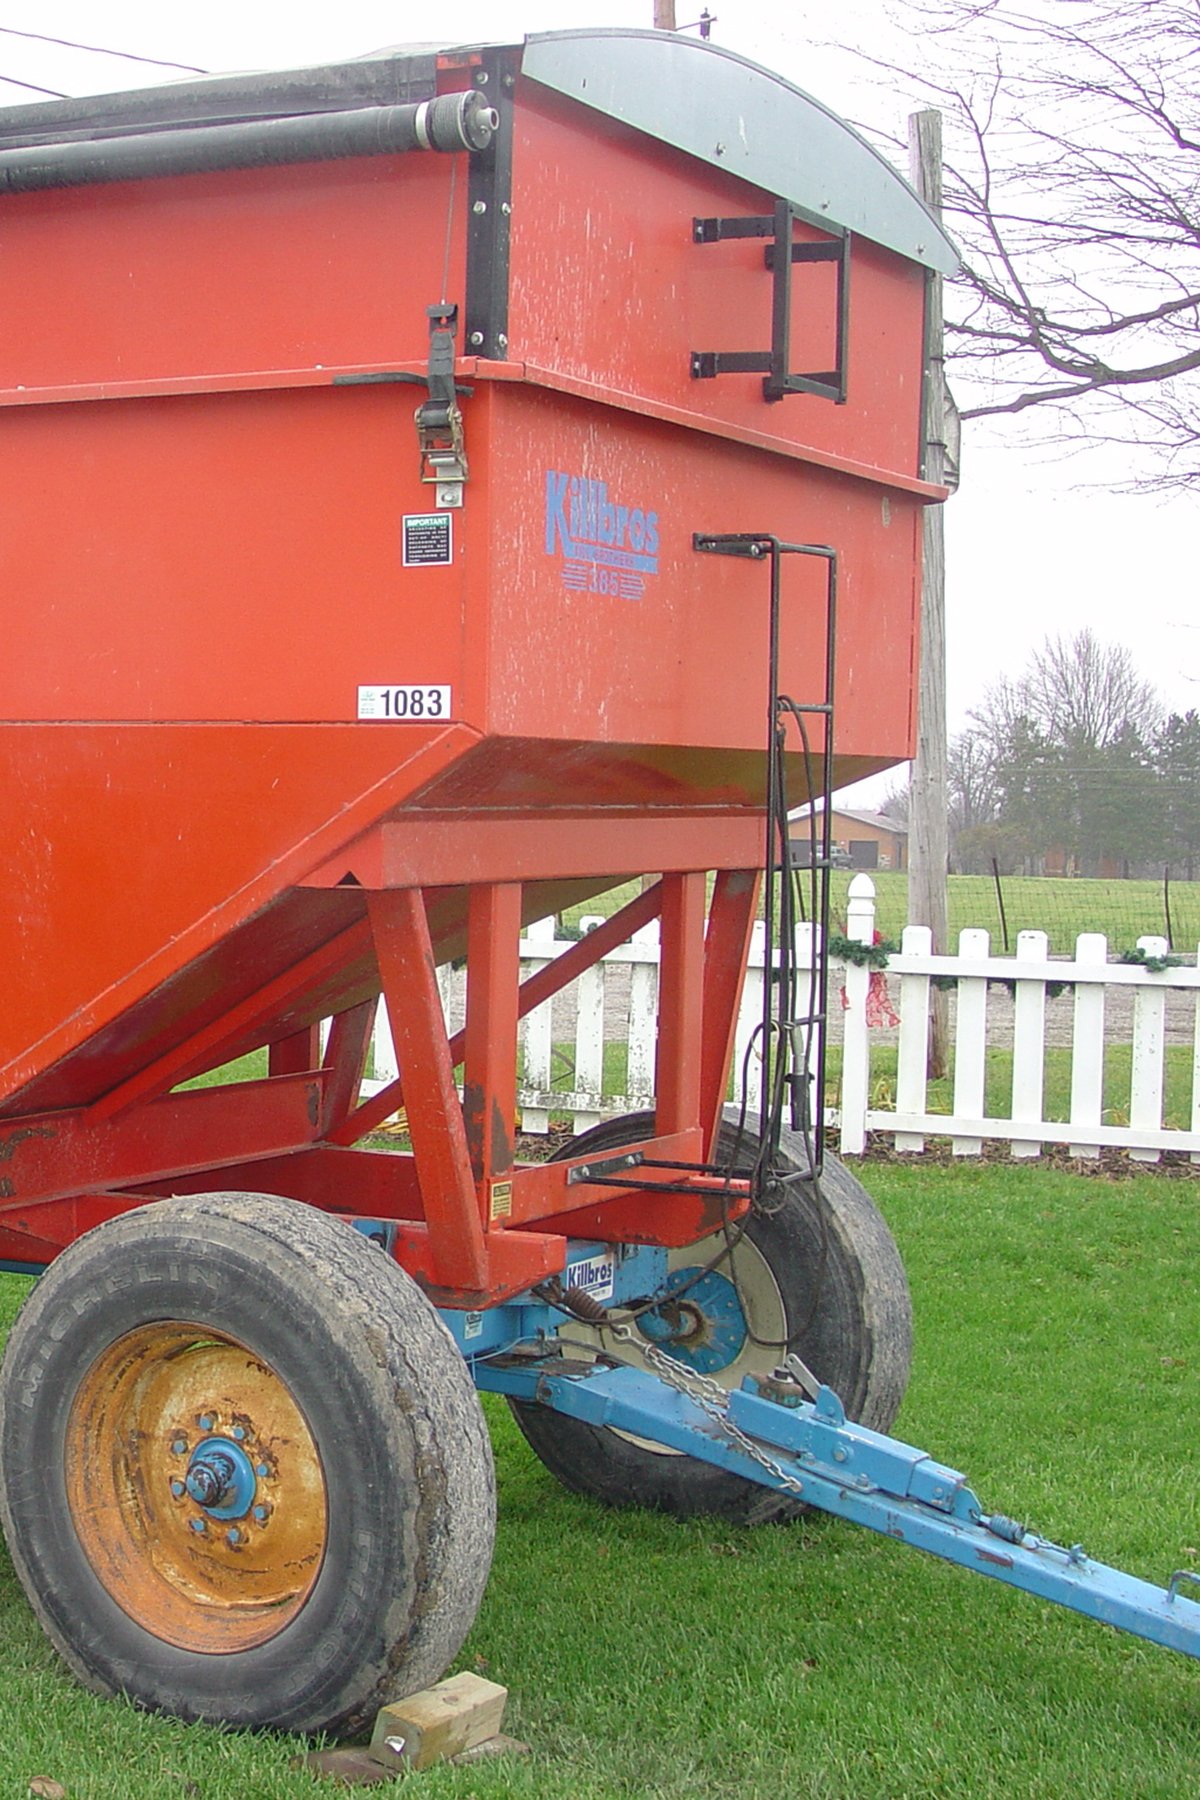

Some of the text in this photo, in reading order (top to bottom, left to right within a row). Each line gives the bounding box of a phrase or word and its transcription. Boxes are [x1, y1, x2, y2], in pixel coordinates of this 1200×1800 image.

[406, 517, 448, 528] IMPORTANT
[545, 469, 660, 555] Killbros
[588, 564, 619, 596] 385
[380, 689, 442, 716] 1083
[569, 1261, 613, 1289] Killbros
[21, 1262, 223, 1408] MICHELIN
